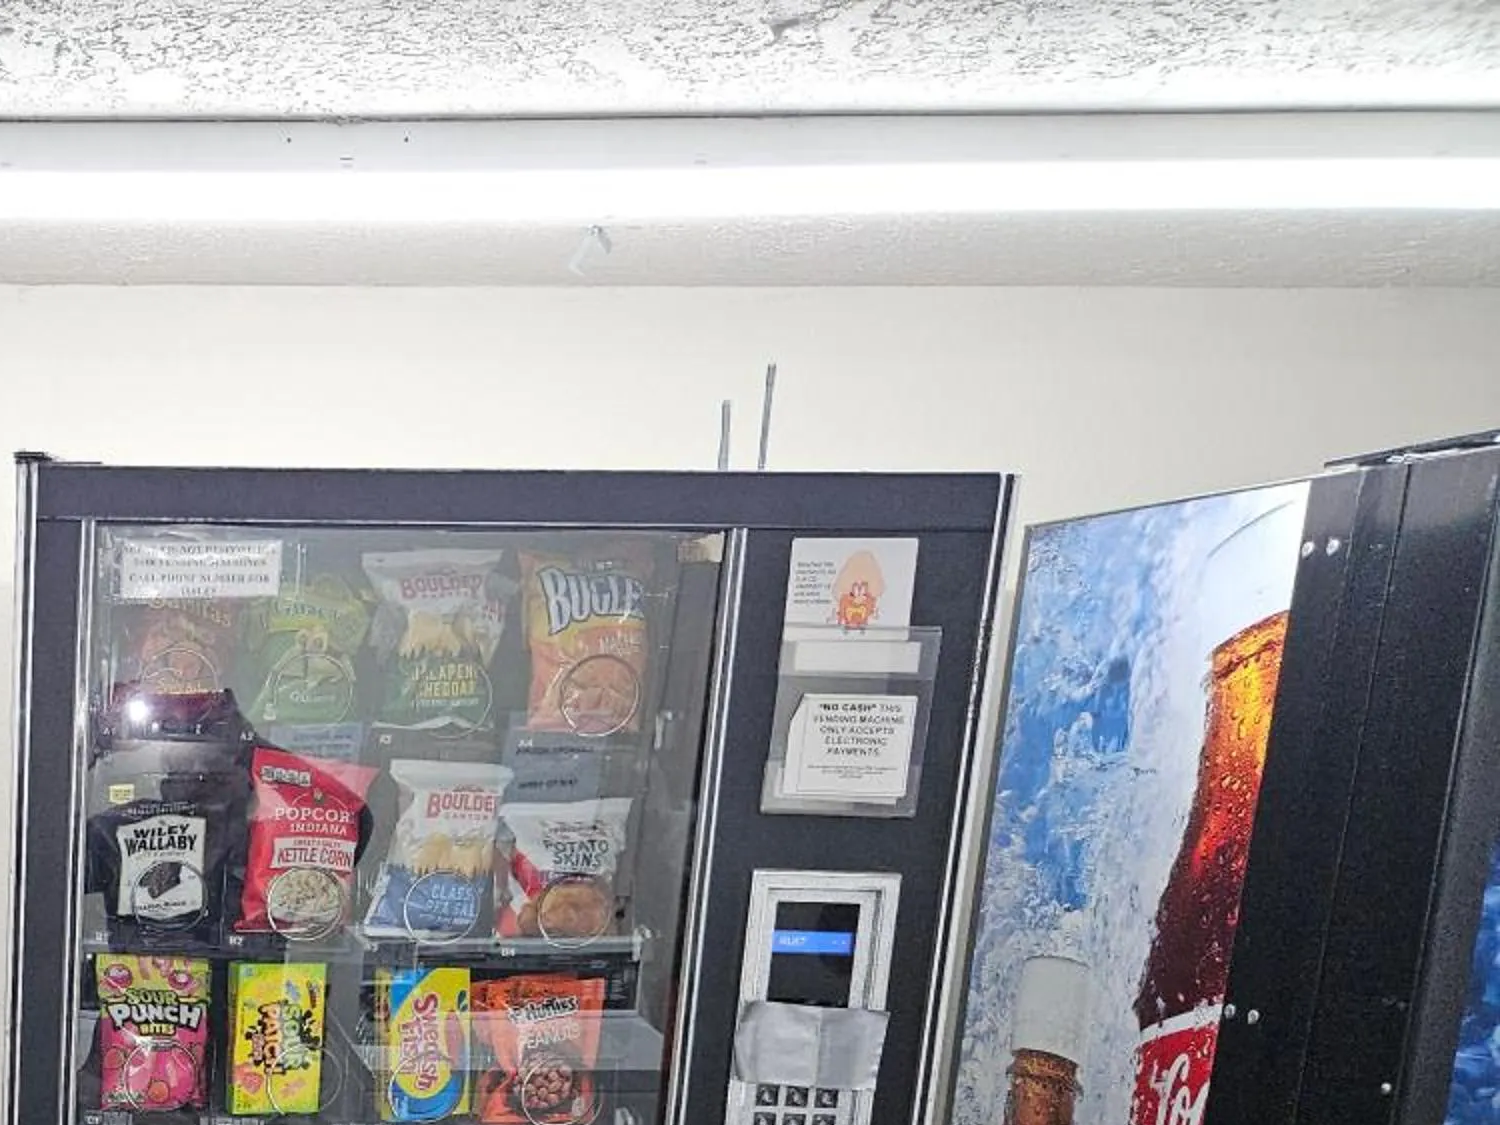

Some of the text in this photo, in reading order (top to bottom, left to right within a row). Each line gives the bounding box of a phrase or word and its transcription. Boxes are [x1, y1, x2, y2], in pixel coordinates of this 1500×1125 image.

[133, 823, 190, 840] WILEY
[290, 823, 347, 836] INDIANA
[124, 834, 197, 856] WALLABY
[542, 839, 610, 853] POTATO
[277, 847, 354, 867] KETTLE CORN
[552, 852, 602, 868] SKINS
[125, 988, 179, 1004] SOUR
[108, 1001, 201, 1030] PUNCH
[138, 1023, 177, 1036] BITES
[412, 993, 439, 1091] Swedish
